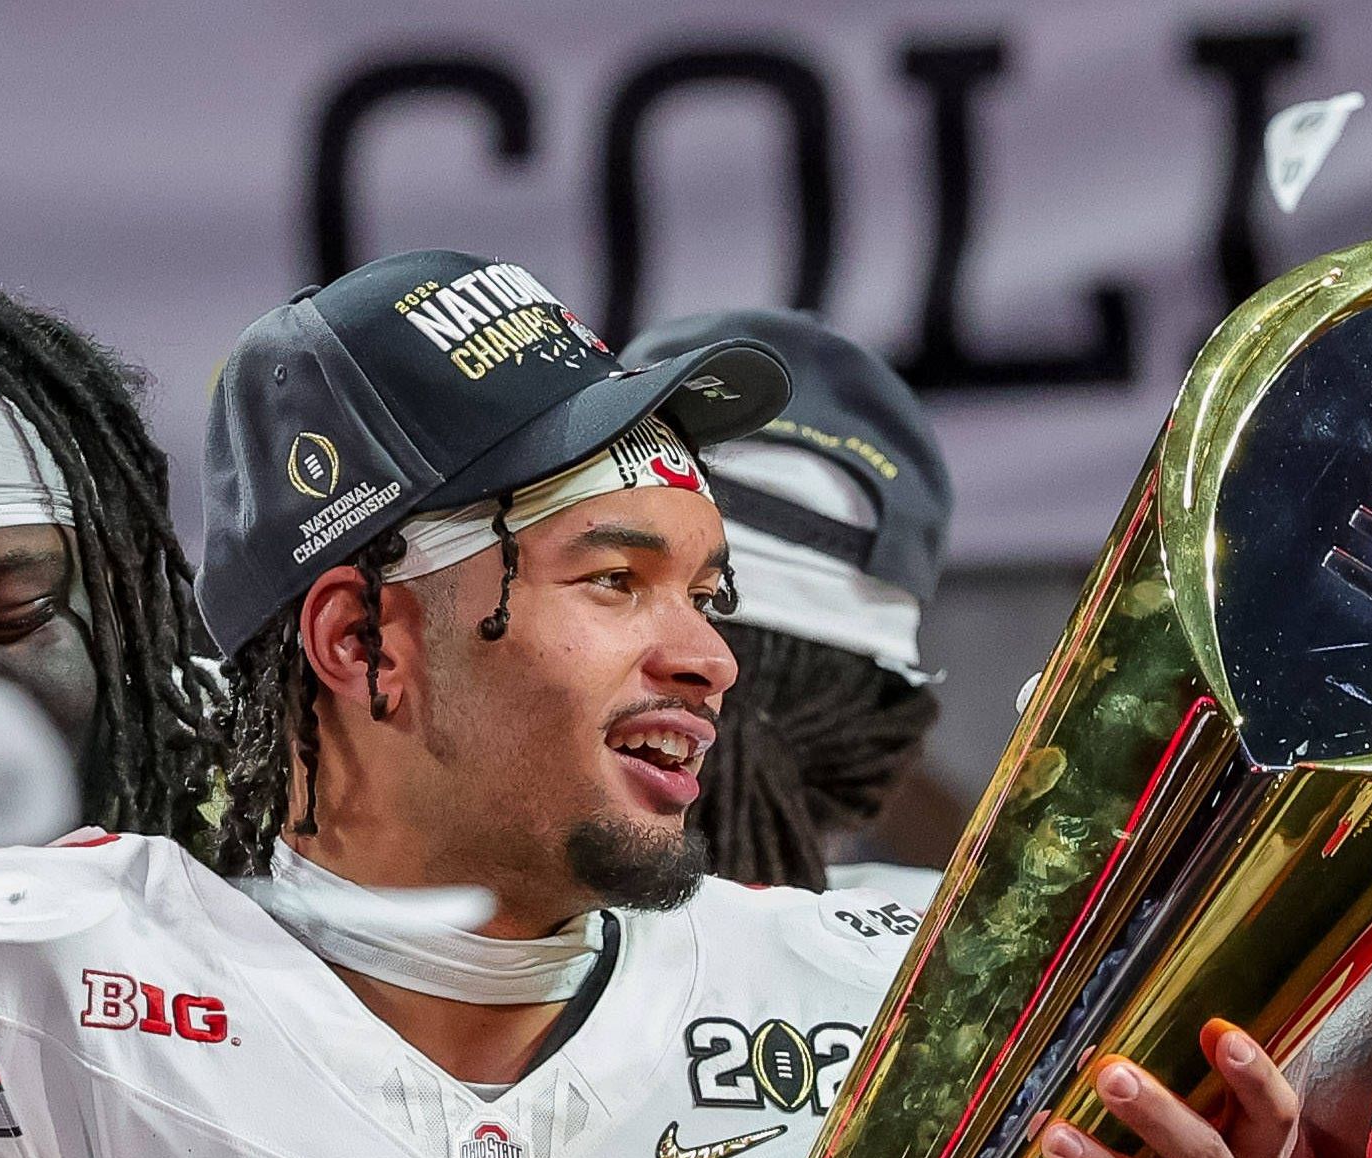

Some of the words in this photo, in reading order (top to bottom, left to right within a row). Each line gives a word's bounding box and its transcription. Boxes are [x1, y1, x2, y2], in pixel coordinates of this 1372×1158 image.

[394, 278, 441, 315] 2024
[449, 304, 564, 381] CHAMPS
[292, 481, 401, 565] CHAMPIONSHIP
[298, 481, 377, 540] NATIONAL
